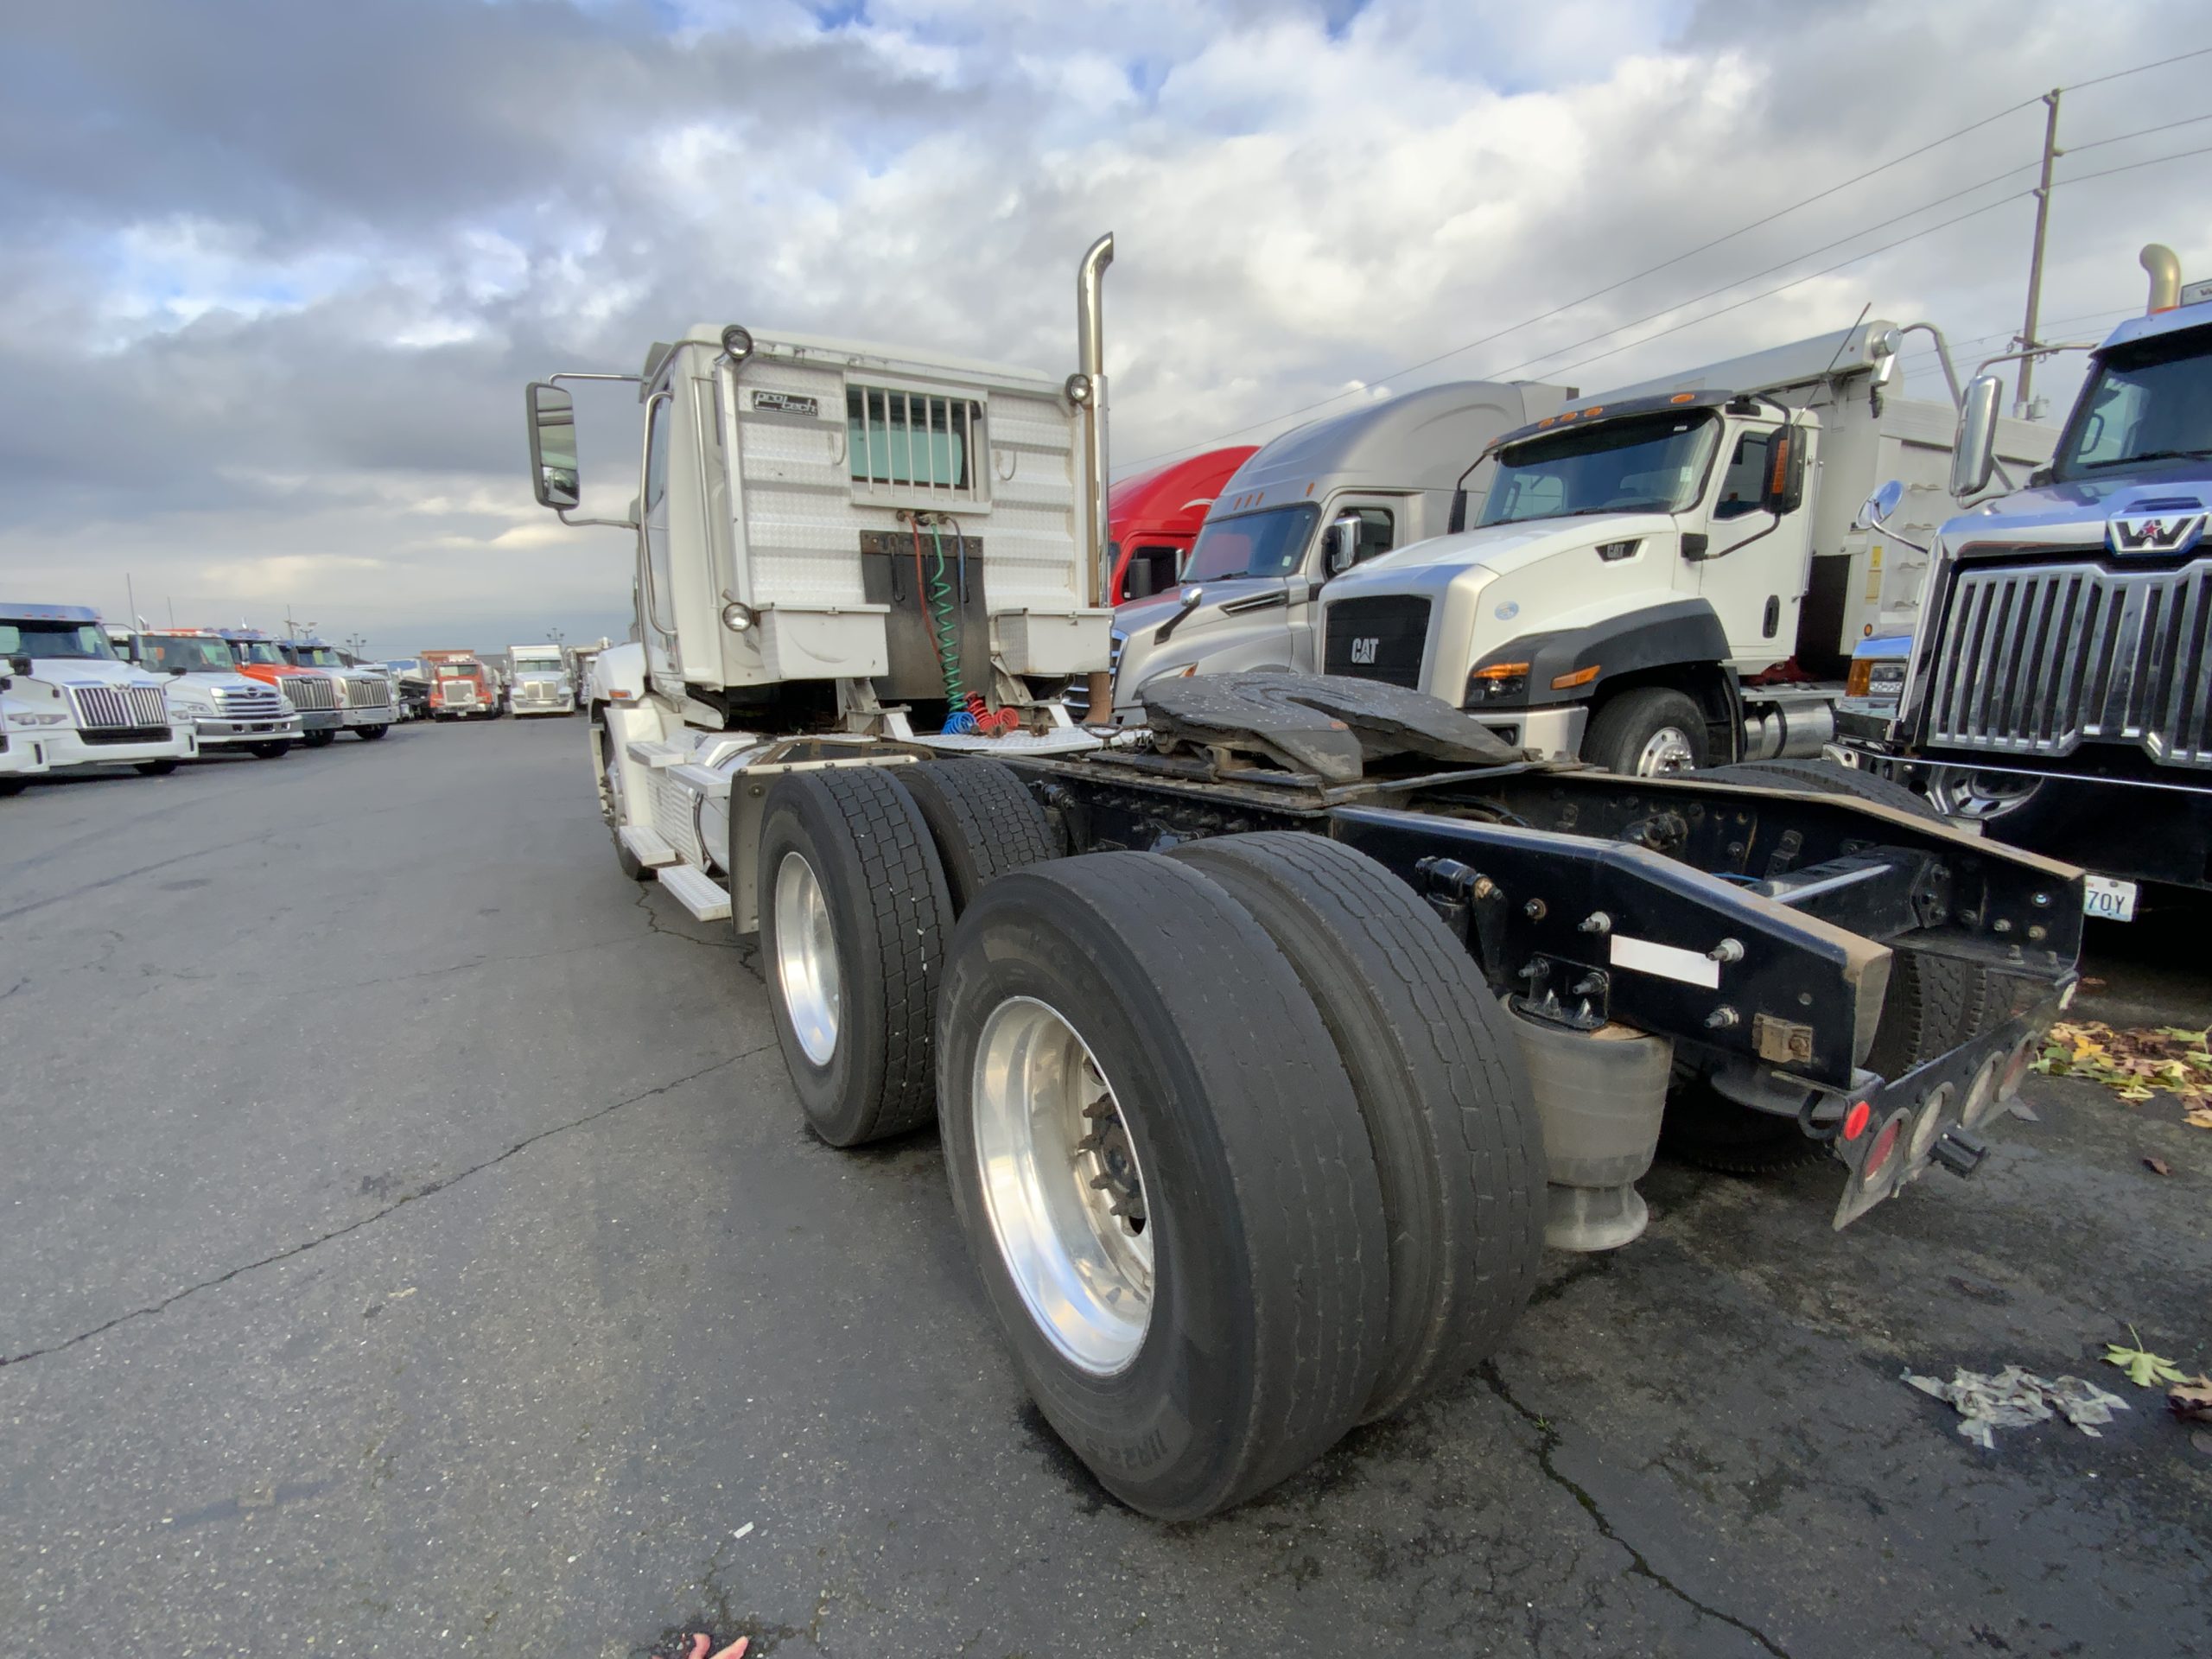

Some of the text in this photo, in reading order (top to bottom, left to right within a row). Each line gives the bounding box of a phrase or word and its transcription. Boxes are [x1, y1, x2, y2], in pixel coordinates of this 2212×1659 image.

[754, 392, 817, 413] pro tech
[1607, 543, 1625, 559] CAT
[1351, 637, 1379, 664] CAT
